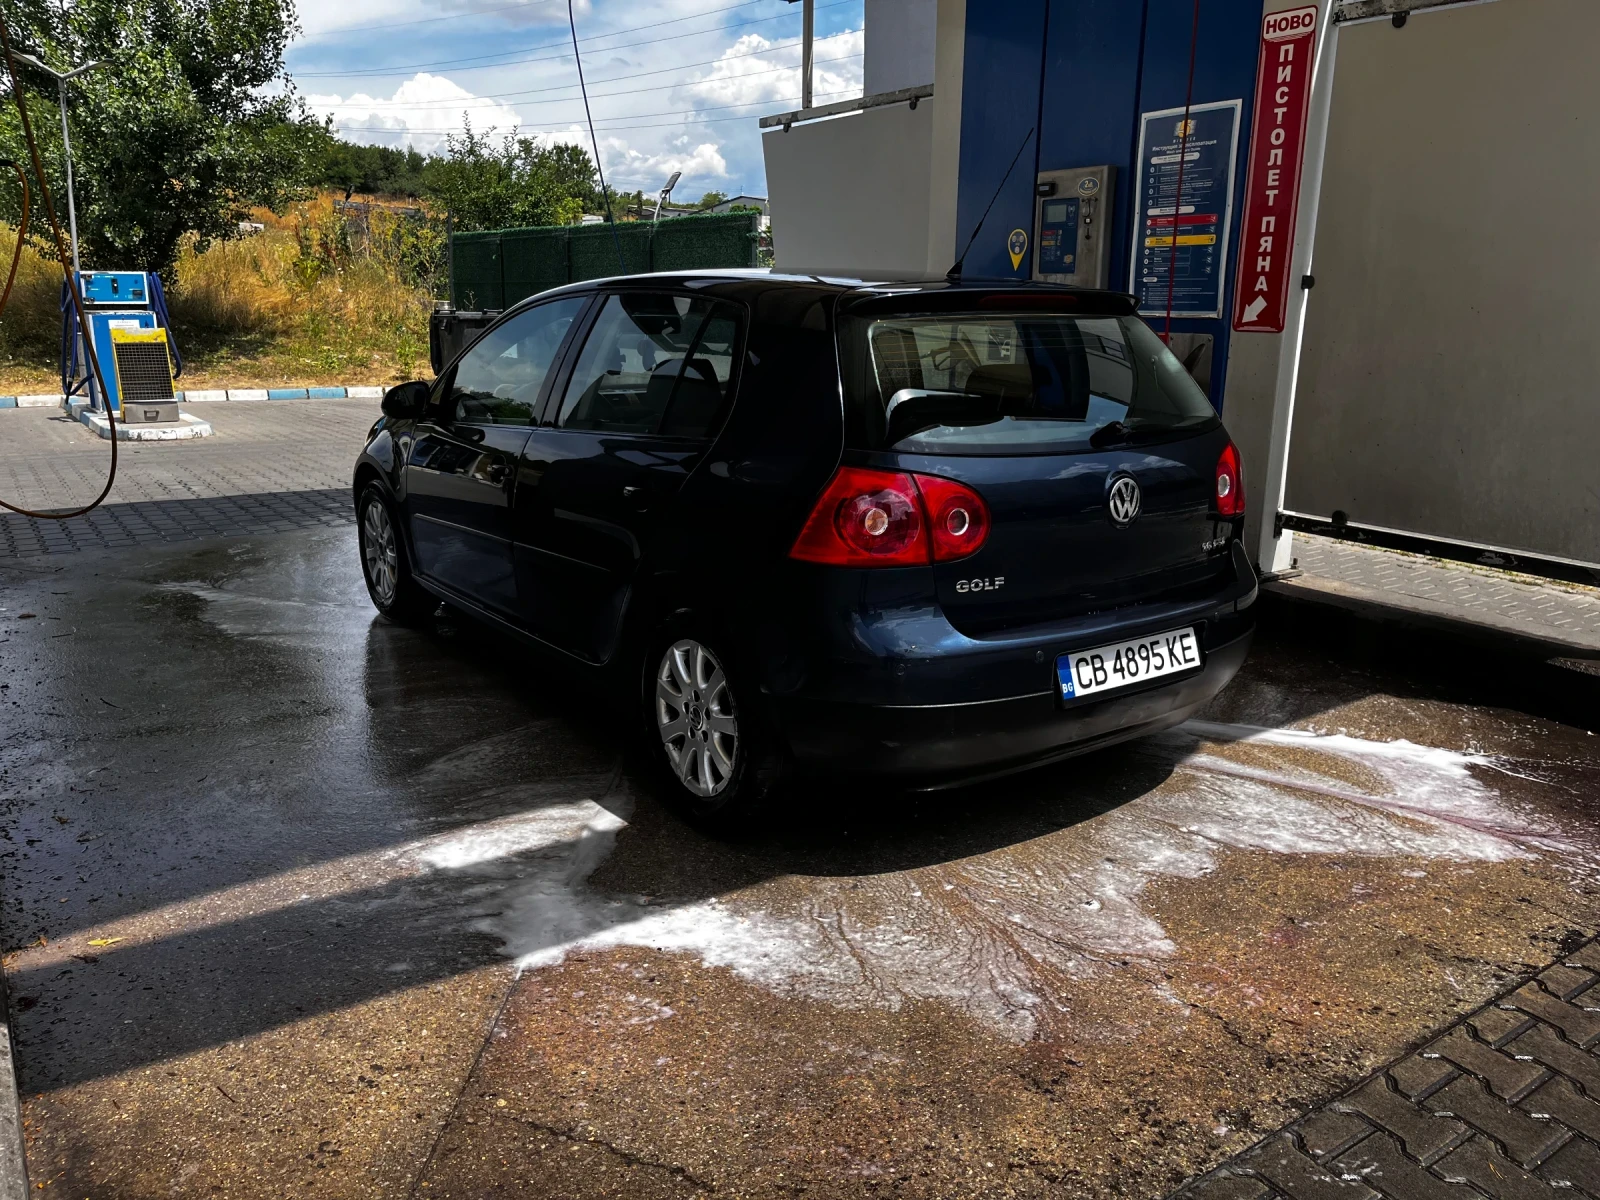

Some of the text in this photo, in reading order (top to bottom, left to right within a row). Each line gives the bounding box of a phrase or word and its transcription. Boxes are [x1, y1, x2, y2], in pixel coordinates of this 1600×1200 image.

[1265, 12, 1314, 35] НОВО
[1254, 43, 1295, 292] ПИСТОЛЕТ ПЯНА
[956, 576, 1005, 593] GOLF
[1075, 632, 1196, 690] CB 4895 KE
[1062, 682, 1074, 693] BG
